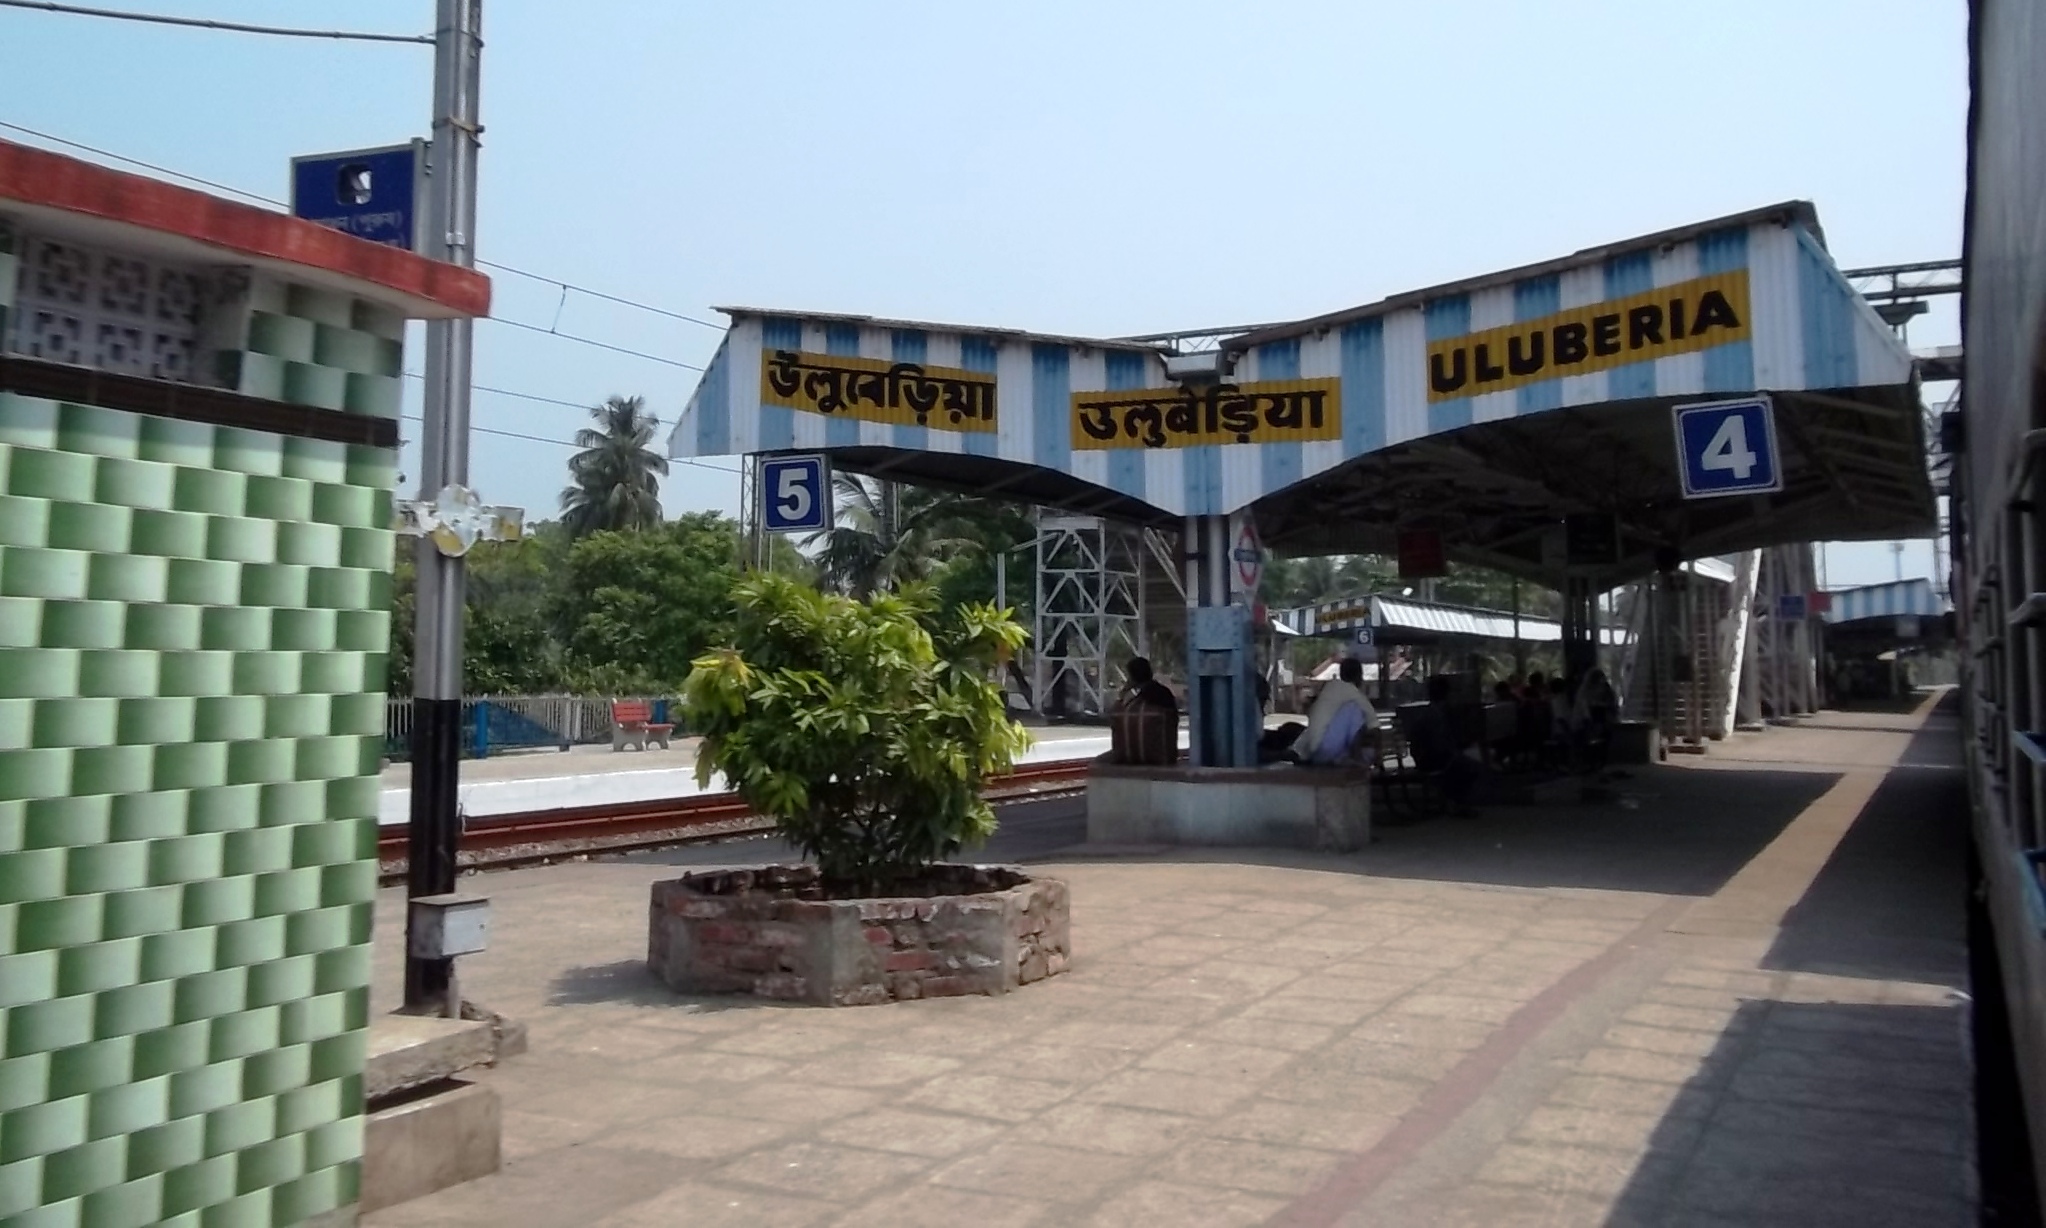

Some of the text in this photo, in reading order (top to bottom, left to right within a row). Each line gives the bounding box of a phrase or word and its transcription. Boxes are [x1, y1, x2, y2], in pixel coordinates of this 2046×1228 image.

[1429, 290, 1741, 393] ULUBERIA
[1701, 414, 1757, 480] 4
[776, 467, 812, 521] 5
[1359, 630, 1369, 644] 6
